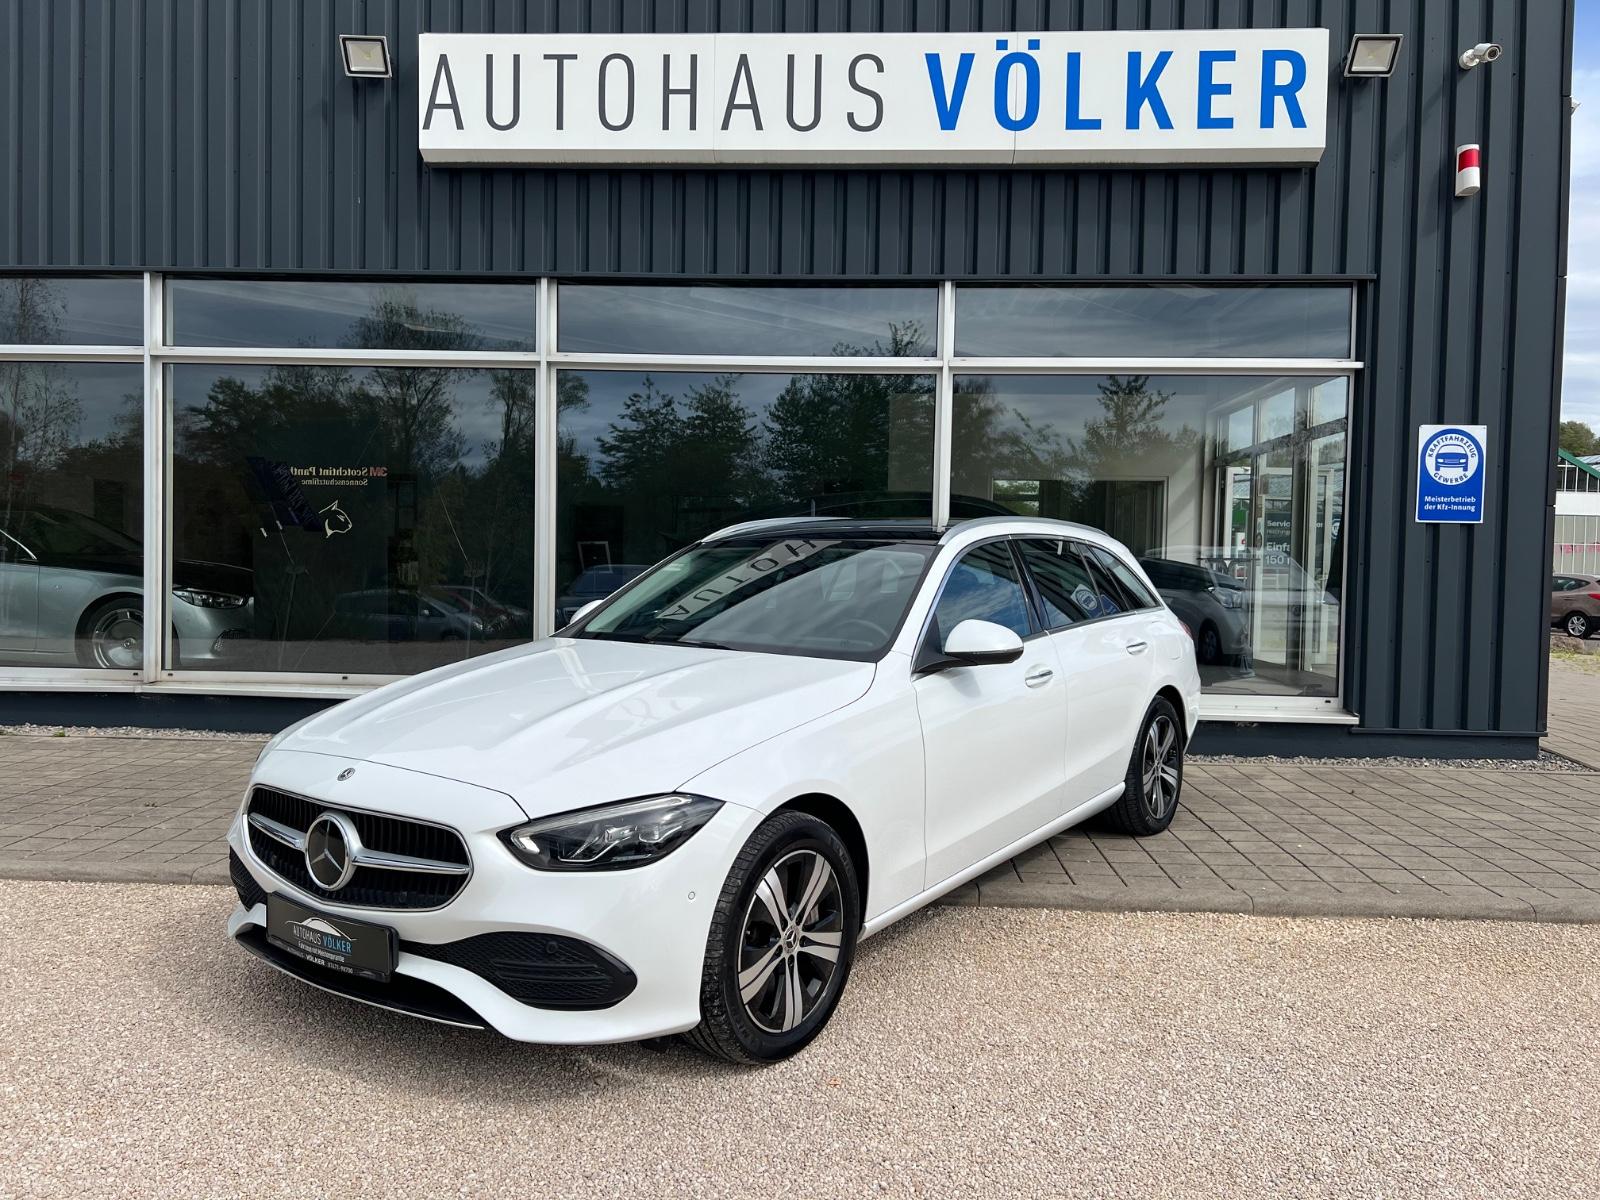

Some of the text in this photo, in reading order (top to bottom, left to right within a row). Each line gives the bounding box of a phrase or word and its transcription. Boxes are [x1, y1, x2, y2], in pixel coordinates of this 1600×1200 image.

[422, 39, 1308, 132] AUTOHAUS VÖLKER
[1427, 435, 1477, 459] KRAFTFAHRZEUG
[1433, 472, 1469, 484] GEWERBE
[1424, 495, 1476, 503] Meisterbetrieb
[1437, 503, 1476, 512] Kfz-Innung
[1265, 555, 1284, 565] 150
[293, 924, 322, 945] AUTOHAUS
[323, 934, 352, 953] VÖLKER
